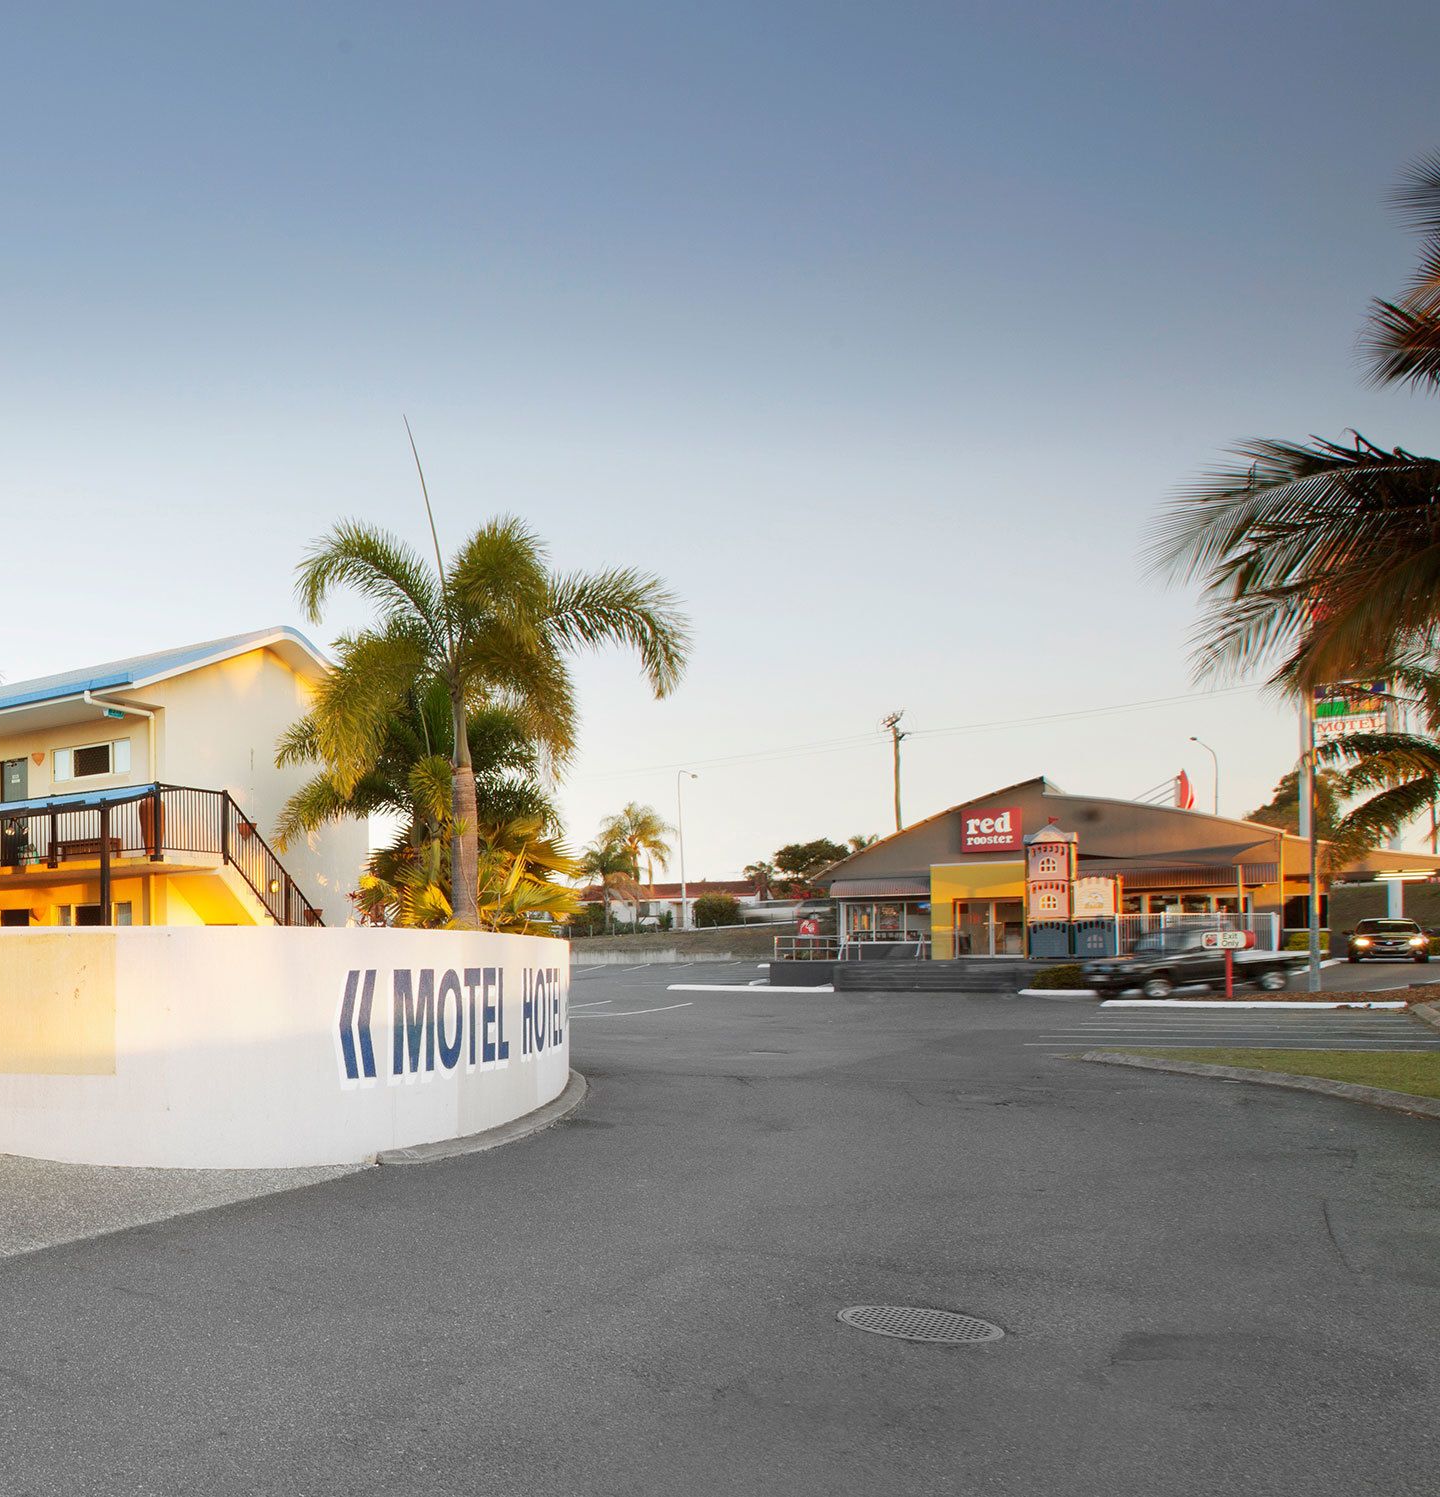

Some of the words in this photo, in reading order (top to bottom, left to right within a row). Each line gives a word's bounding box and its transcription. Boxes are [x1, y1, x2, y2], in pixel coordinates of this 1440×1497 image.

[1317, 718, 1377, 733] MOTEL
[966, 811, 1013, 835] red
[966, 835, 1014, 846] rooster
[1222, 932, 1238, 940] Exit
[392, 967, 509, 1075] MOTEL
[522, 967, 563, 1055] HOTEL
